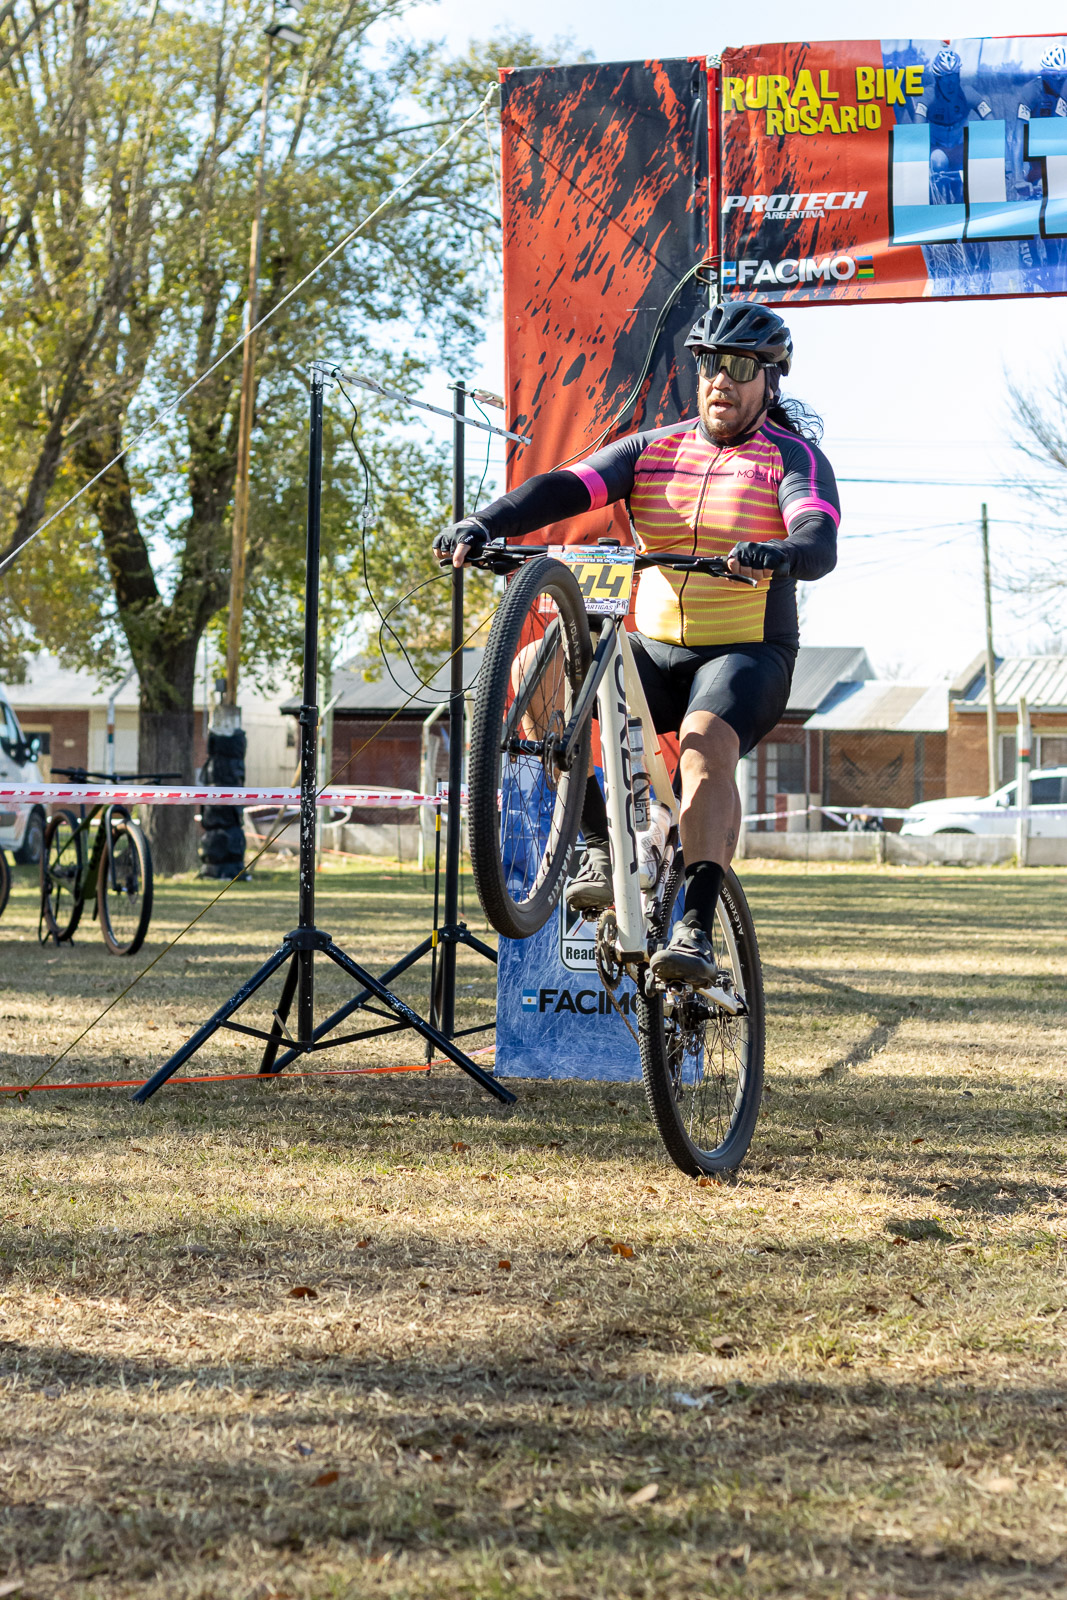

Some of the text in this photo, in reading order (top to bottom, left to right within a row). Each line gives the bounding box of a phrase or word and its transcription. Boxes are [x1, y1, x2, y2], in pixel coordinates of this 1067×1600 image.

[723, 65, 925, 113] RURAL BIKE
[766, 103, 882, 136] ROSARIO
[721, 190, 868, 214] PROTECH
[762, 209, 826, 220] ARGENTINA
[738, 255, 857, 285] FACIMO
[566, 564, 626, 598] 44
